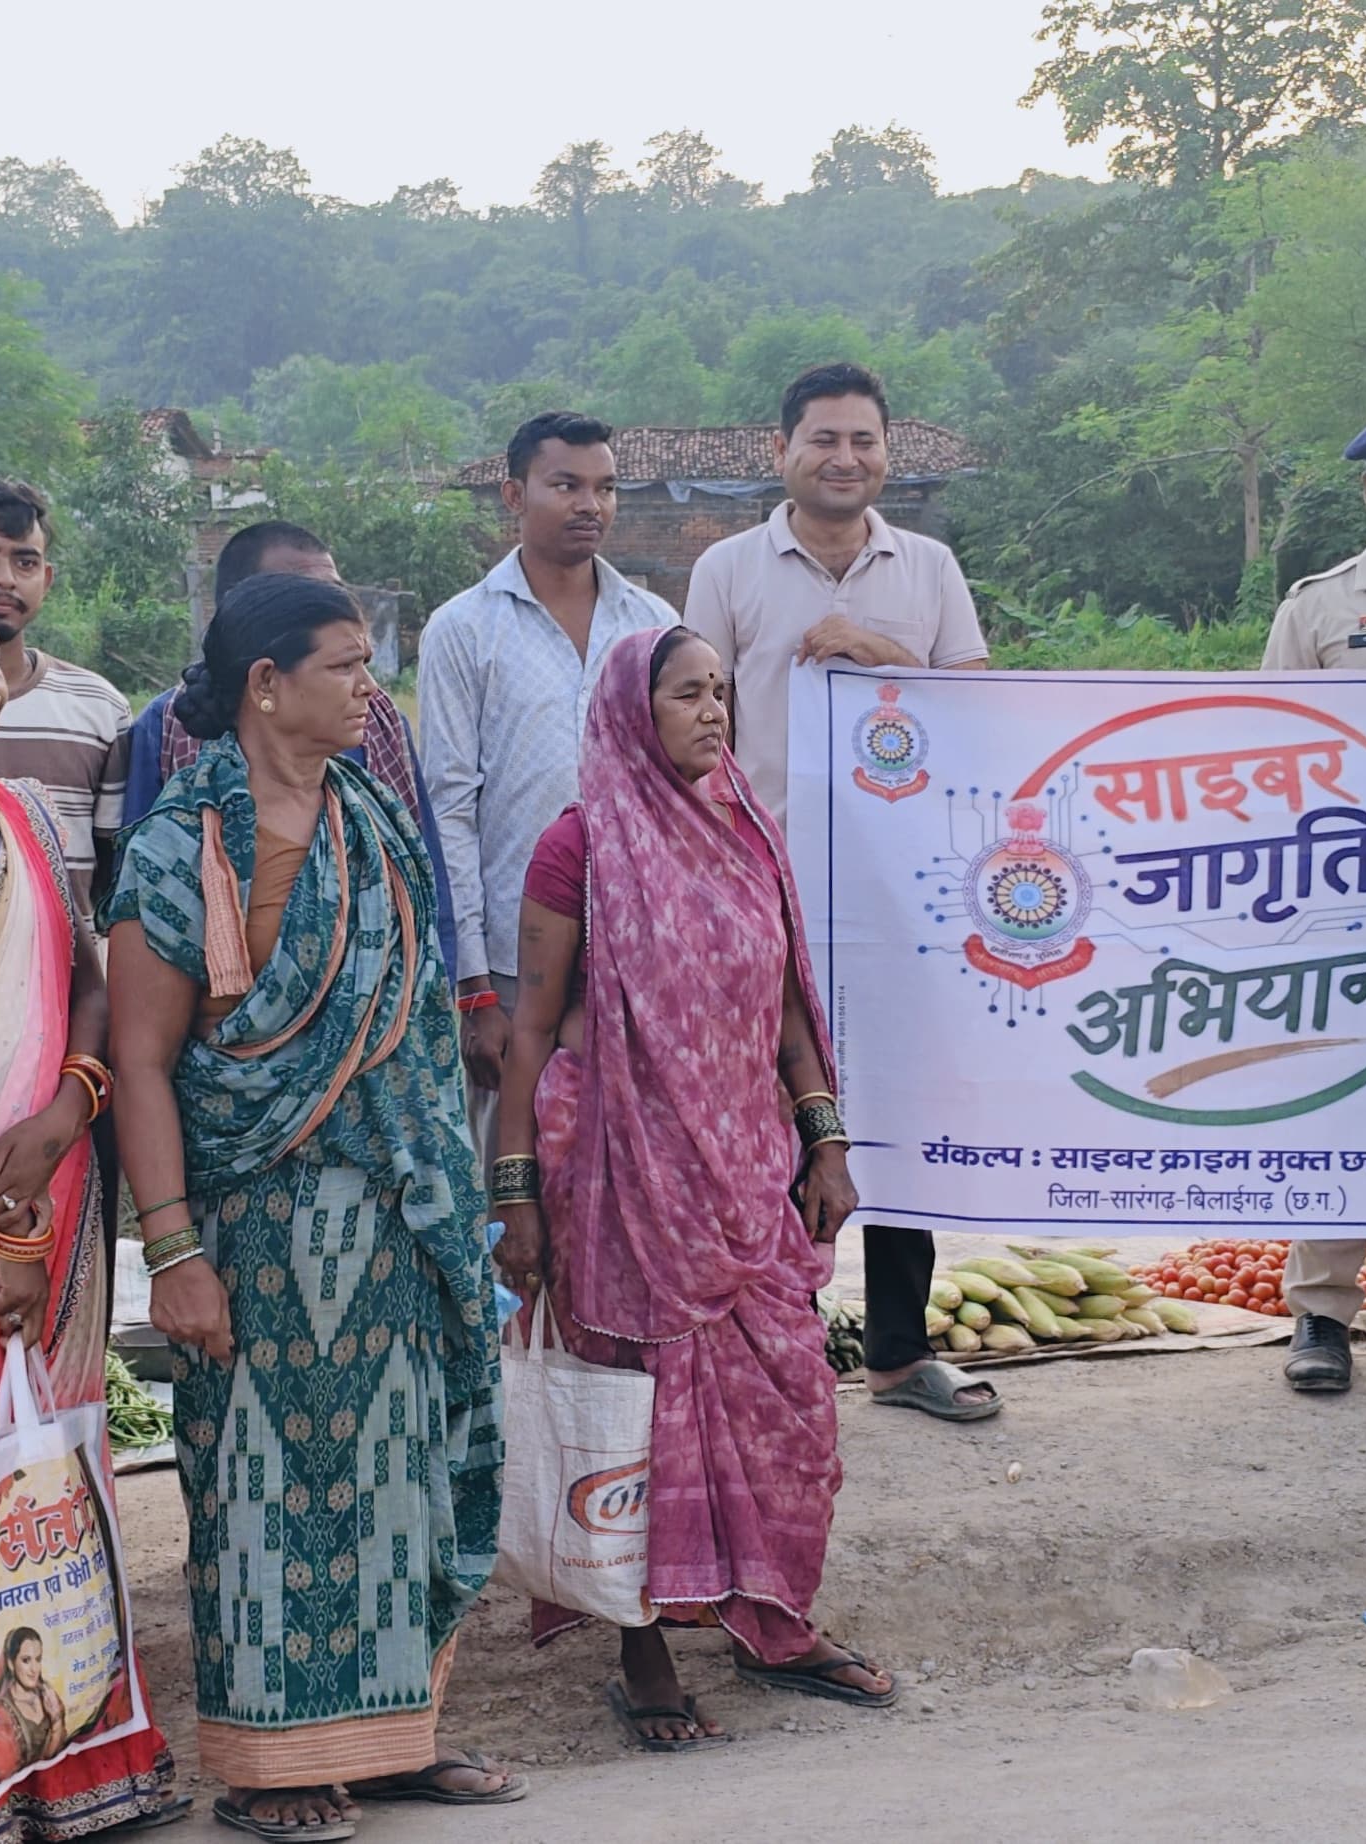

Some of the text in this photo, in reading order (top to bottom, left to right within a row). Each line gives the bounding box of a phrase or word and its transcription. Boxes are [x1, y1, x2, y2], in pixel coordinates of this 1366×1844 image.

[1083, 740, 1361, 824] साइबर
[921, 1136, 1022, 1168] संकल्प
[1051, 1148, 1153, 1173] साइबर
[1158, 1148, 1252, 1173] क्राइम
[1258, 1150, 1333, 1182] मुक्त
[1285, 1186, 1348, 1217] (छ.ग.)
[608, 1552, 635, 1567] LOW
